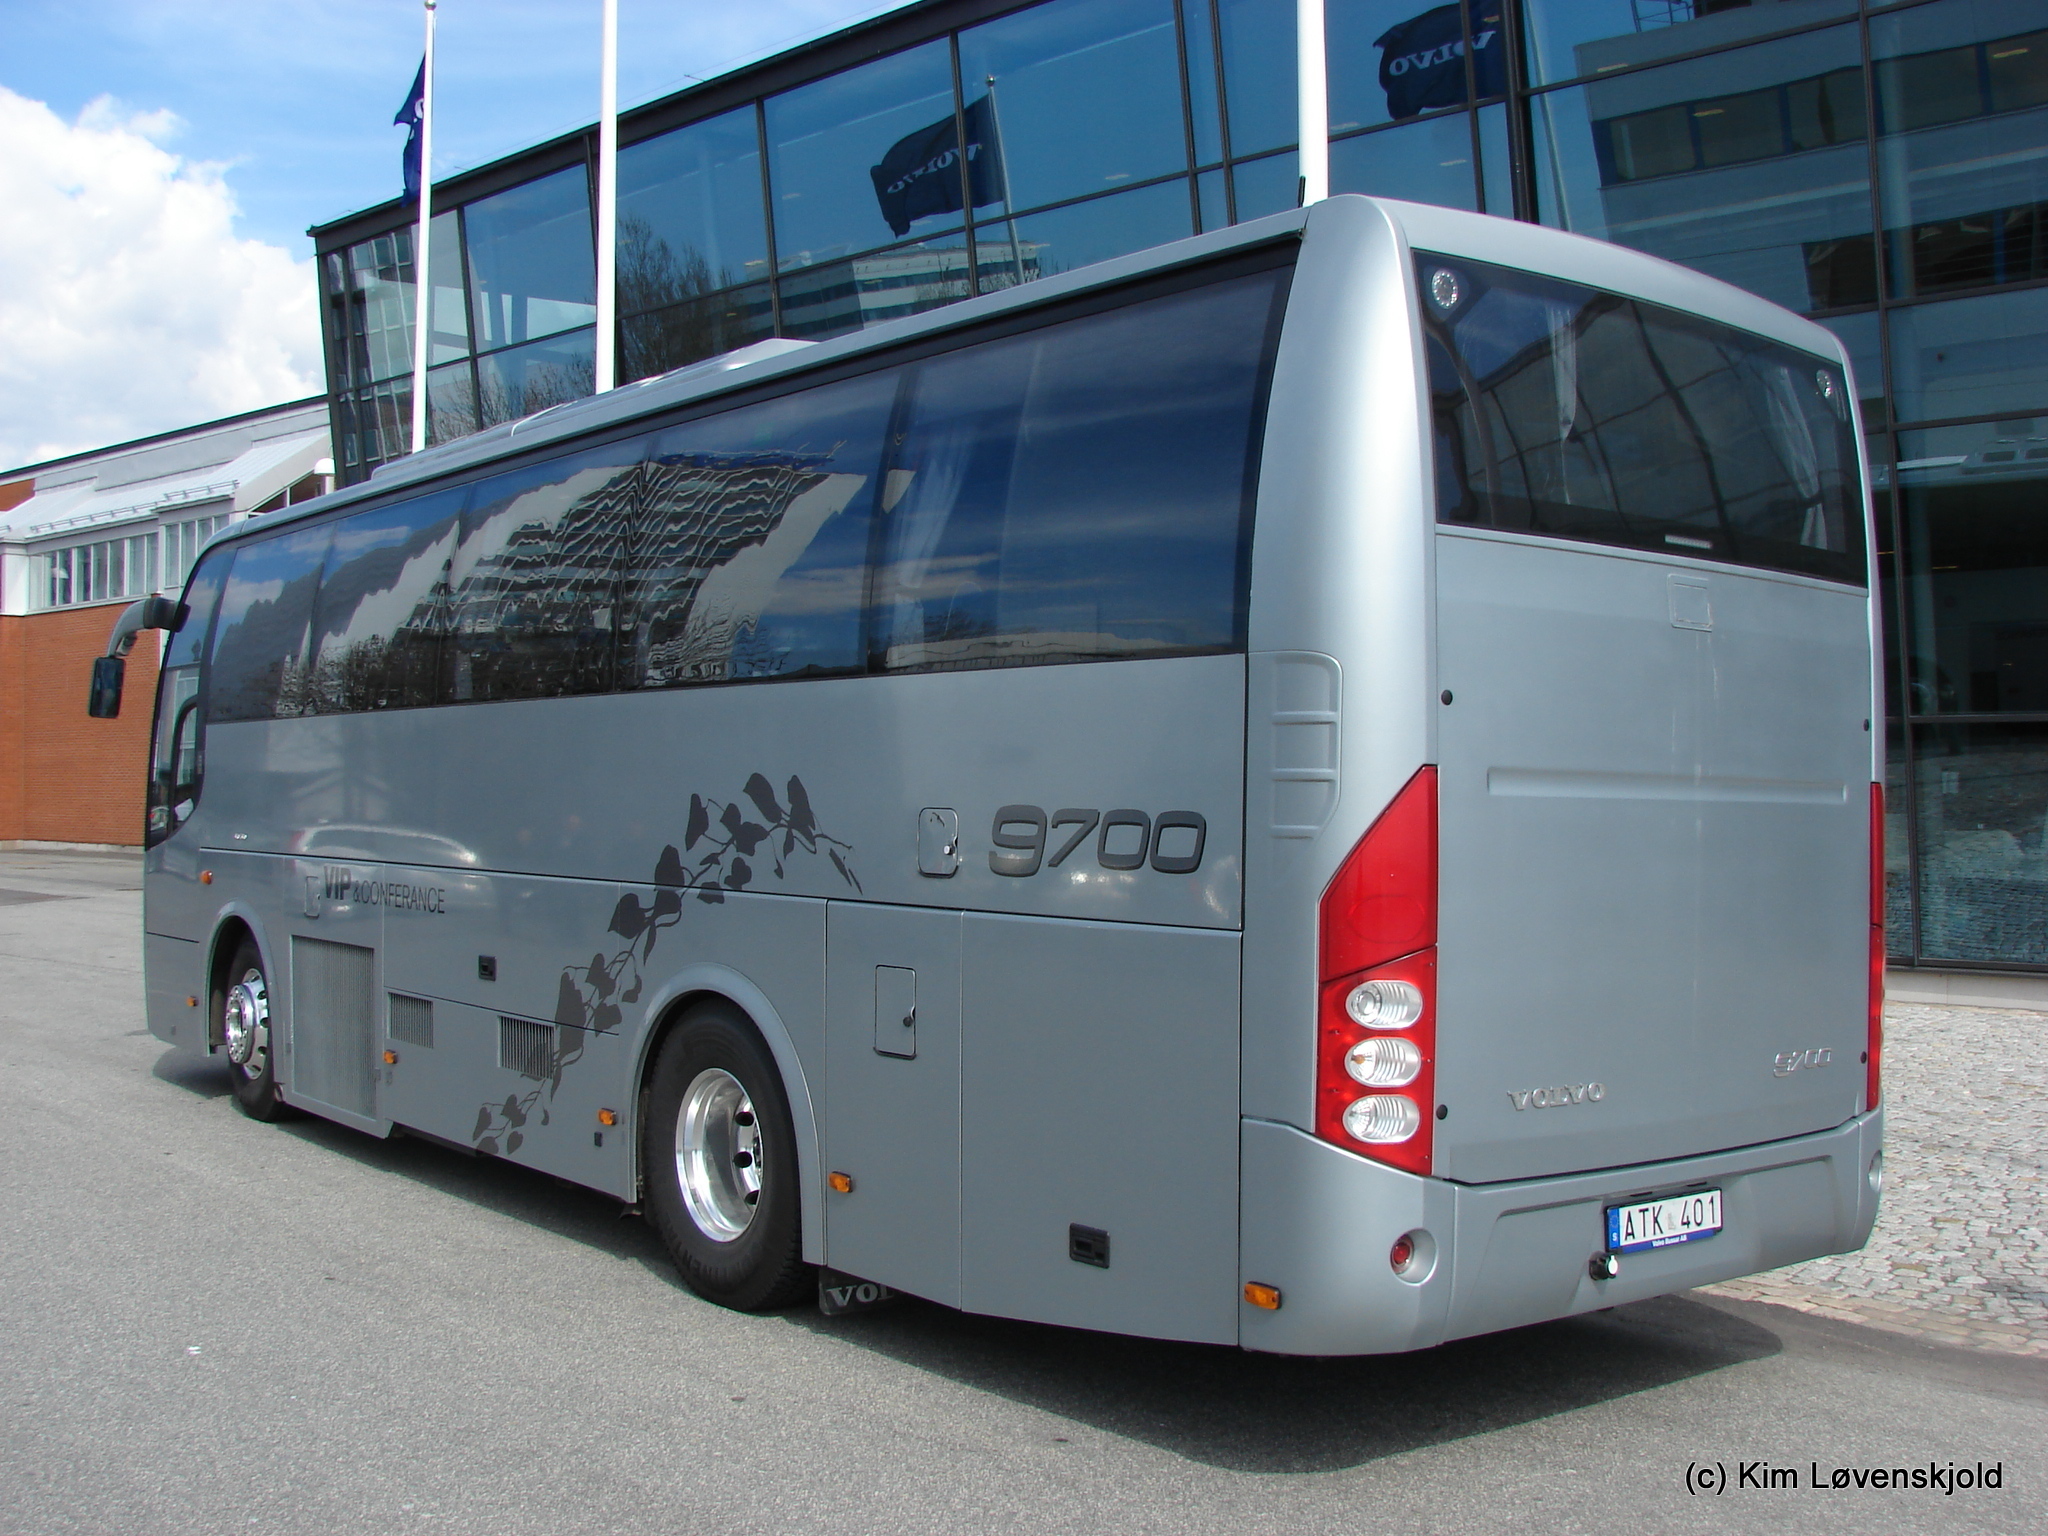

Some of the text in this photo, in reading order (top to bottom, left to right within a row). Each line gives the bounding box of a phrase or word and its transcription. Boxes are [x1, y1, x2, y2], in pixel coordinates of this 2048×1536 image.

[988, 804, 1207, 878] 9700
[323, 865, 352, 900] VIP
[1773, 1047, 1832, 1078] 9700
[1507, 1082, 1606, 1111] VOLVO
[1624, 1195, 1715, 1241] ATK 401
[1612, 1232, 1618, 1242] S
